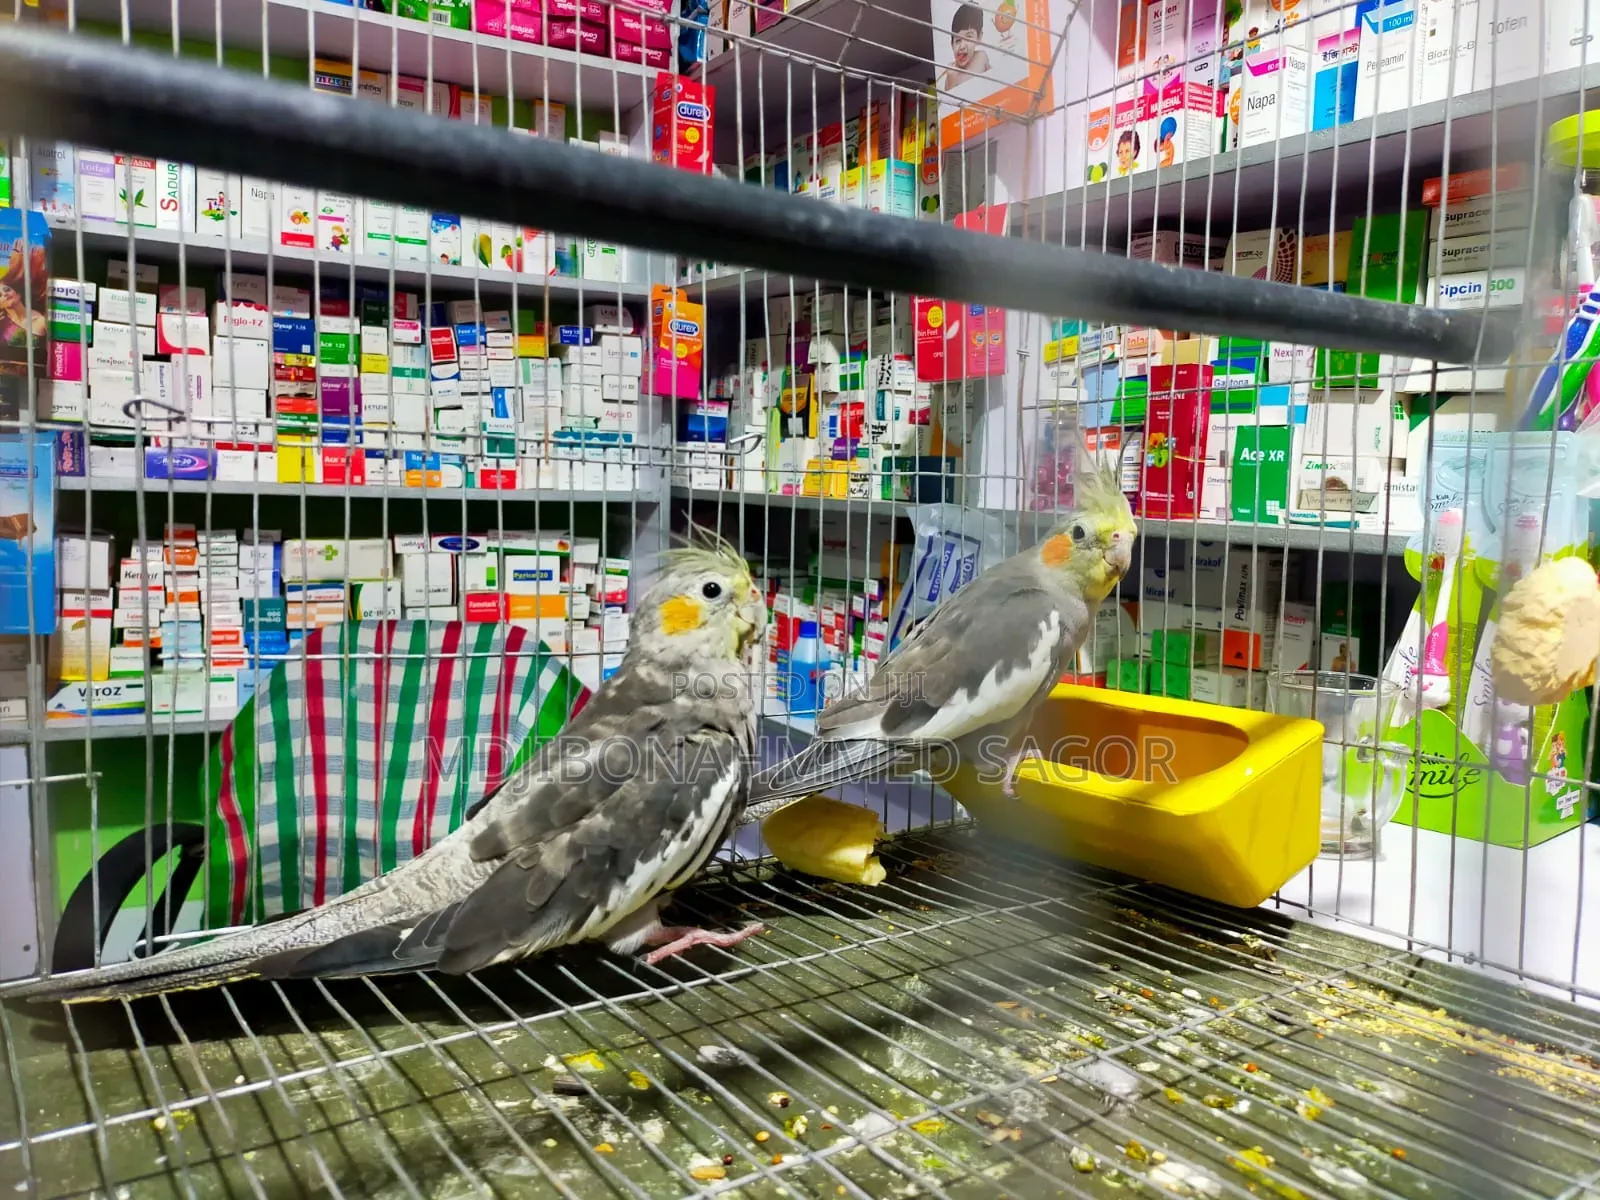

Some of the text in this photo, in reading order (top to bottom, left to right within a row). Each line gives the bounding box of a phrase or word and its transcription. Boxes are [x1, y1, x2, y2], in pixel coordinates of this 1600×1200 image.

[1389, 14, 1413, 28] 100 ml
[1488, 15, 1528, 36] Tofen
[1288, 55, 1306, 72] Napa
[1247, 93, 1276, 111] Napa
[1240, 447, 1285, 462] Ace XR
